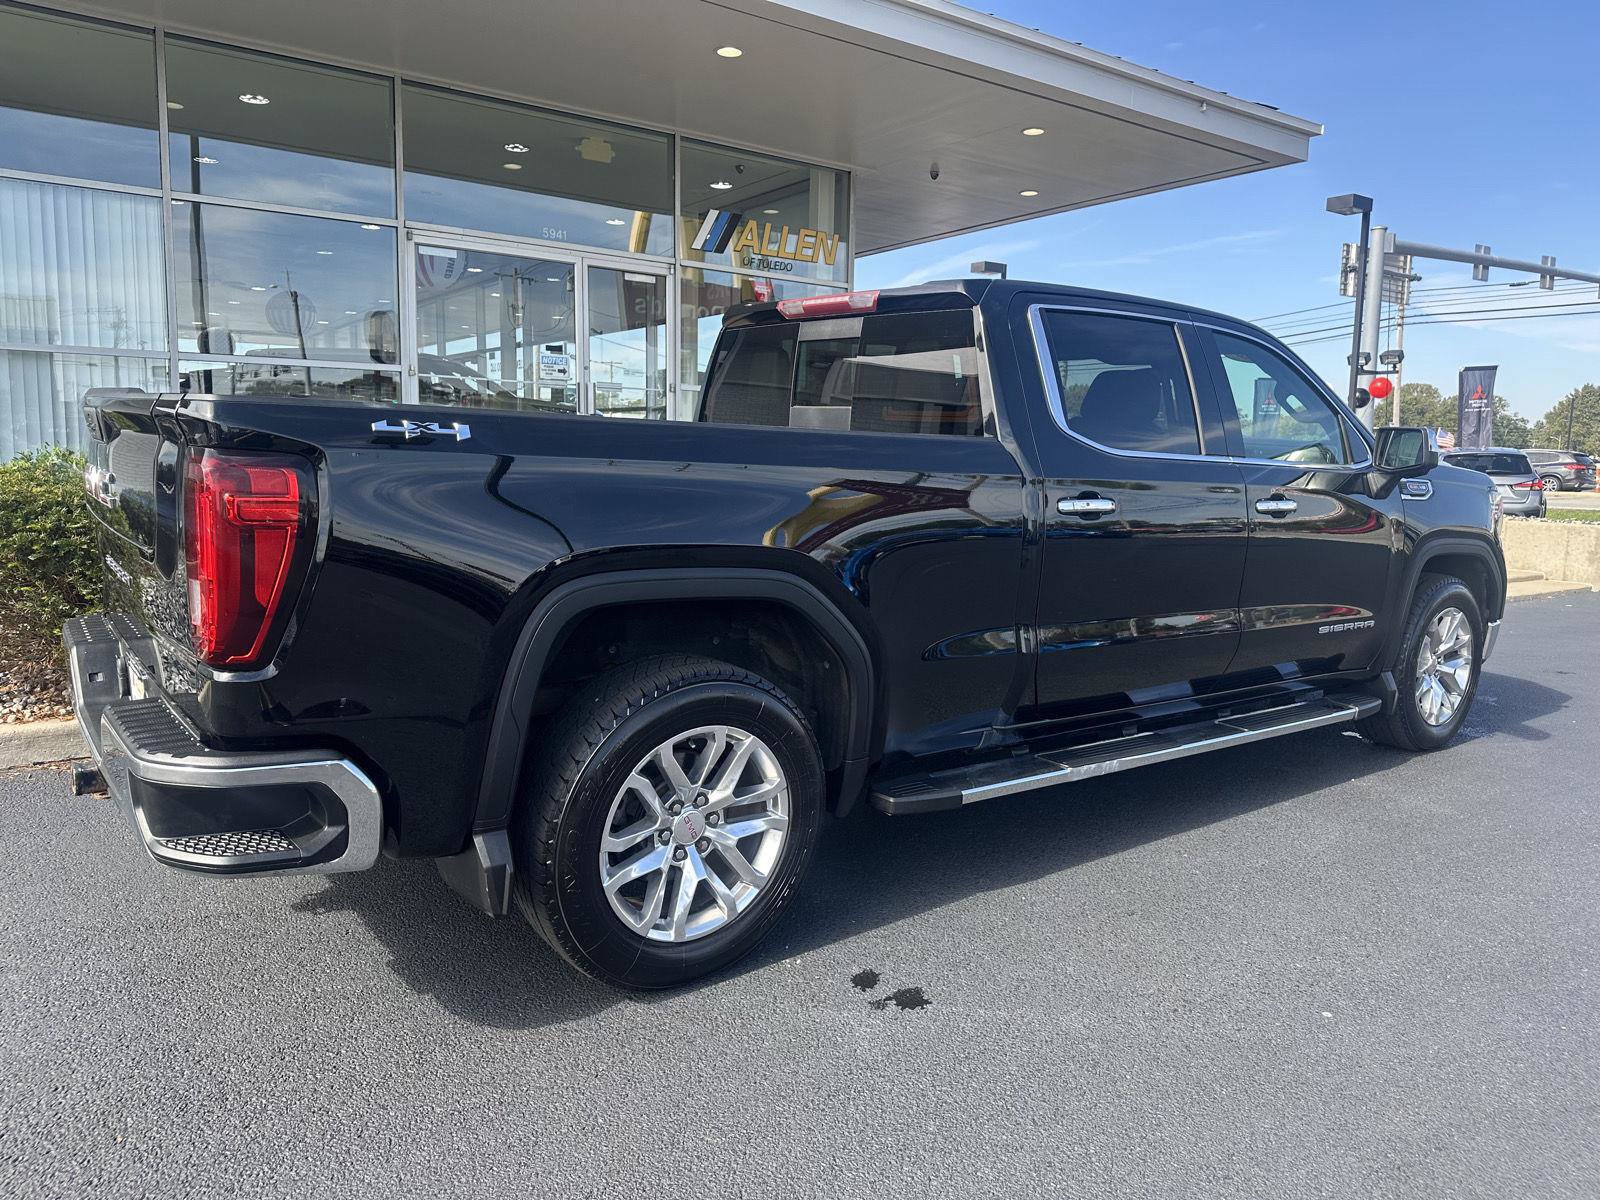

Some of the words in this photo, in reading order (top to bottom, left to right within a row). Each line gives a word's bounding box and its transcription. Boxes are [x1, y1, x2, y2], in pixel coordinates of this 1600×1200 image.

[542, 227, 567, 241] 5941
[734, 219, 839, 265] ALLEN
[743, 256, 755, 268] OF
[757, 258, 793, 272] TOLEDO
[542, 355, 568, 366] NOTICE
[1318, 619, 1376, 634] SIERRA
[683, 815, 698, 839] GMC
